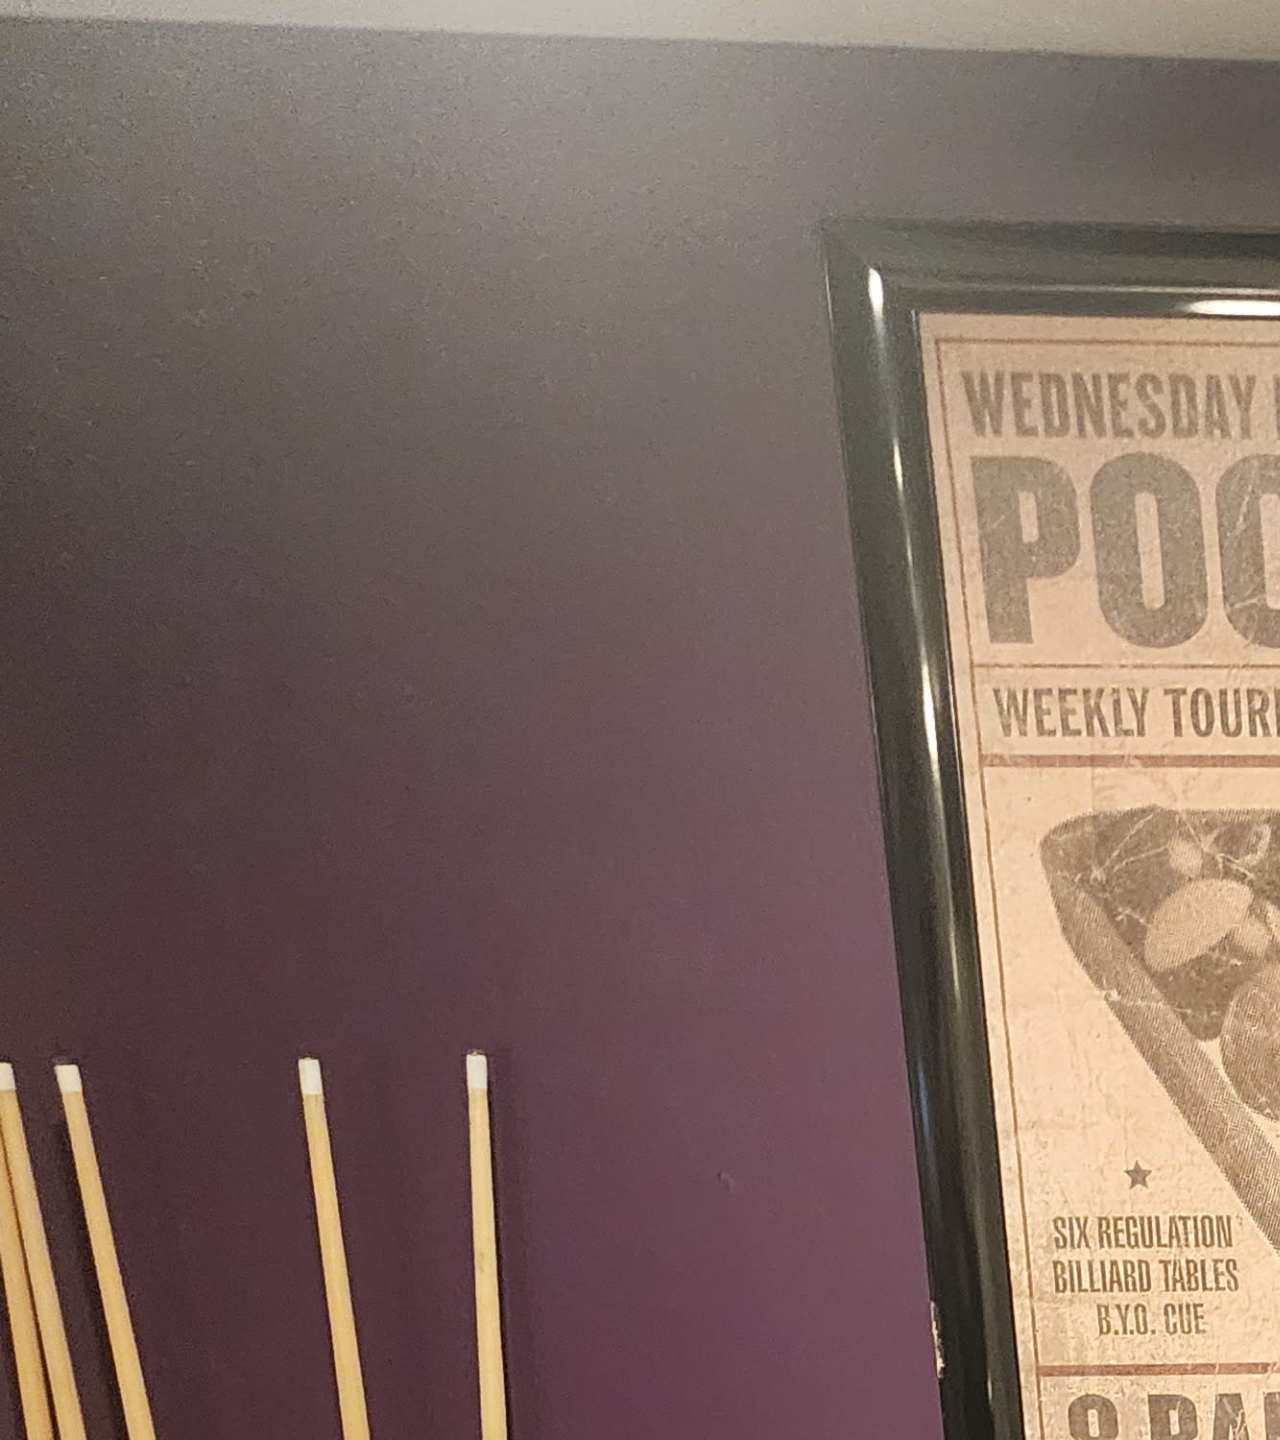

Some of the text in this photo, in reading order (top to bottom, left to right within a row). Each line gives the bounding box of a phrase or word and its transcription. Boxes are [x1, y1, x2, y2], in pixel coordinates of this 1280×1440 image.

[962, 370, 1256, 441] WEDNESDAY
[994, 687, 1149, 738] WEEKLY
[1053, 1215, 1233, 1249] SIX REGULATION
[1053, 1259, 1240, 1294] BILLIARD TABLES
[1098, 1303, 1206, 1336] B.Y.O. CUE
